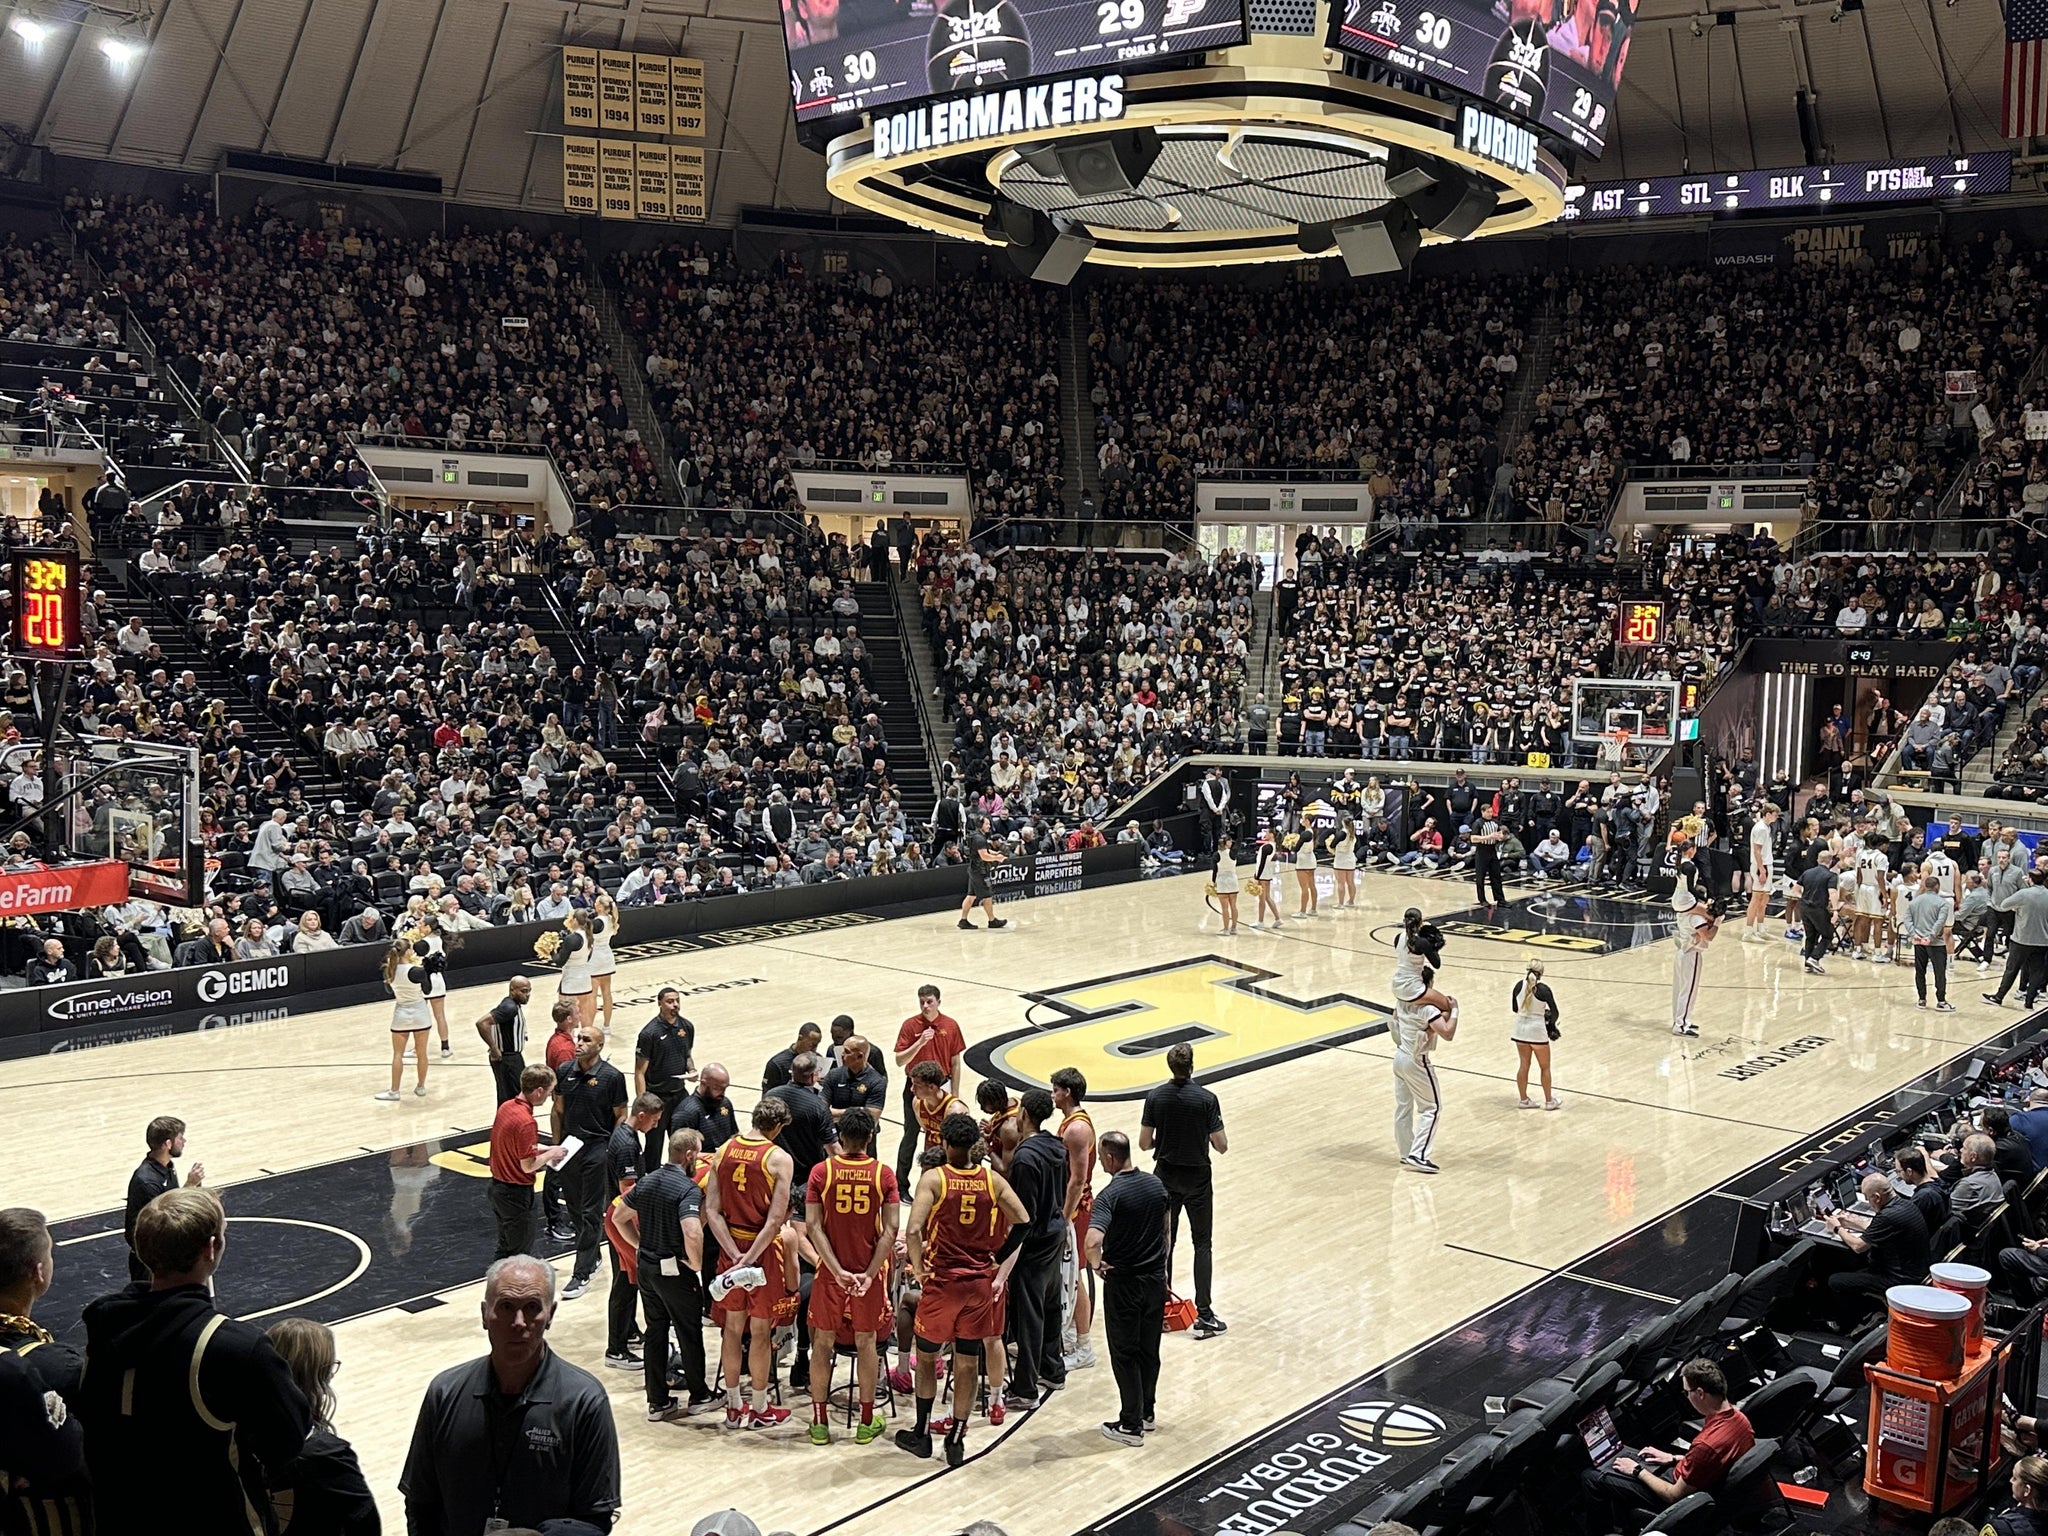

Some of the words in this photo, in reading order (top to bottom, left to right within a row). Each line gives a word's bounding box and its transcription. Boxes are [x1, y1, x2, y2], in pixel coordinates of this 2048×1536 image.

[1097, 0, 1145, 35] 29
[948, 9, 1001, 42] 3:24
[1416, 12, 1451, 50] 30
[1118, 43, 1156, 59] FOULS
[566, 55, 595, 65] PURDUE
[603, 59, 630, 69] PURDUE
[1388, 50, 1416, 69] FOULS
[639, 62, 666, 72] PURDUE
[674, 66, 701, 76] PURDUE
[844, 50, 876, 84] 30
[565, 74, 596, 83] WOMEN'S
[602, 77, 631, 87] WOMEN'S
[581, 83, 592, 91] TEN
[638, 81, 667, 91] WOMEN'S
[673, 85, 703, 94] WOMEN'S
[568, 90, 594, 99] CHAMPS
[604, 93, 630, 102] CHAMPS
[653, 90, 665, 98] TEN
[640, 97, 666, 106] CHAMPS
[675, 100, 702, 109] CHAMPS
[831, 99, 855, 114] FOULS
[1572, 87, 1592, 119] 29
[570, 106, 592, 119] 1991
[605, 109, 629, 122] 1994
[641, 113, 665, 125] 1995
[873, 74, 1127, 160] BOILERMAKERS
[677, 116, 701, 128] 1997
[1462, 106, 1539, 174] PURDUE
[567, 145, 595, 155] PURDUE
[603, 148, 631, 158] PURDUE
[639, 151, 667, 161] PURDUE
[674, 155, 702, 164] PURDUE
[1954, 159, 1969, 171] 11
[565, 163, 596, 173] WOMEN'S
[602, 167, 632, 176] WOMEN'S
[638, 170, 668, 179] WOMEN'S
[1902, 167, 1926, 179] FAST
[568, 179, 594, 188] CHAMPS
[674, 173, 703, 182] WOMEN'S
[1866, 169, 1901, 192] PTS
[1902, 176, 1933, 190] BREAK
[604, 182, 631, 191] CHAMPS
[640, 185, 666, 194] CHAMPS
[676, 188, 702, 197] CHAMPS
[1770, 176, 1804, 199] BLK
[1681, 183, 1711, 204] STL
[569, 195, 593, 208] 1998
[606, 198, 630, 210] 1999
[642, 201, 665, 213] 1999
[1592, 189, 1624, 212] AST
[676, 204, 701, 216] 2000
[1794, 224, 1865, 251] PAINT
[1886, 231, 1921, 240] SECTION
[1888, 238, 1919, 259] 114
[824, 255, 848, 272] 112
[1714, 255, 1774, 266] WABASH
[873, 492, 883, 501] EXIT
[31, 560, 66, 590] 3:24
[1633, 605, 1660, 618] 3:24
[27, 592, 63, 646] 20
[1628, 619, 1656, 640] 20
[1780, 662, 1818, 674] TIME
[1824, 663, 1845, 675] TO
[1850, 665, 1889, 677] PLAY
[1896, 665, 1940, 678] HARD
[1035, 854, 1058, 865] CENTRAL
[1059, 852, 1082, 863] MIDWEST
[1861, 858, 1872, 869] 24
[1035, 865, 1082, 881] CARPENTERS
[1937, 866, 1949, 876] 17
[1905, 891, 1912, 901] 4
[229, 966, 288, 994] GEMCO
[678, 977, 768, 997] KEADY
[67, 989, 172, 1014] InnerVision
[76, 1011, 97, 1019] UNITY
[99, 1004, 141, 1015] HEALTHCARE
[143, 1000, 173, 1009] PARTNER
[1770, 1035, 1835, 1059] KEADY
[1716, 1056, 1787, 1082] COURT
[728, 1147, 757, 1161] MULDER
[732, 1163, 747, 1191] 4
[835, 1168, 872, 1182] MITCHELL
[948, 1178, 987, 1191] JEFFERSON
[835, 1184, 871, 1214] 55
[959, 1195, 977, 1225] 5
[1209, 1432, 1343, 1500] GLOBAL
[1217, 1442, 1392, 1536] PURDUE
